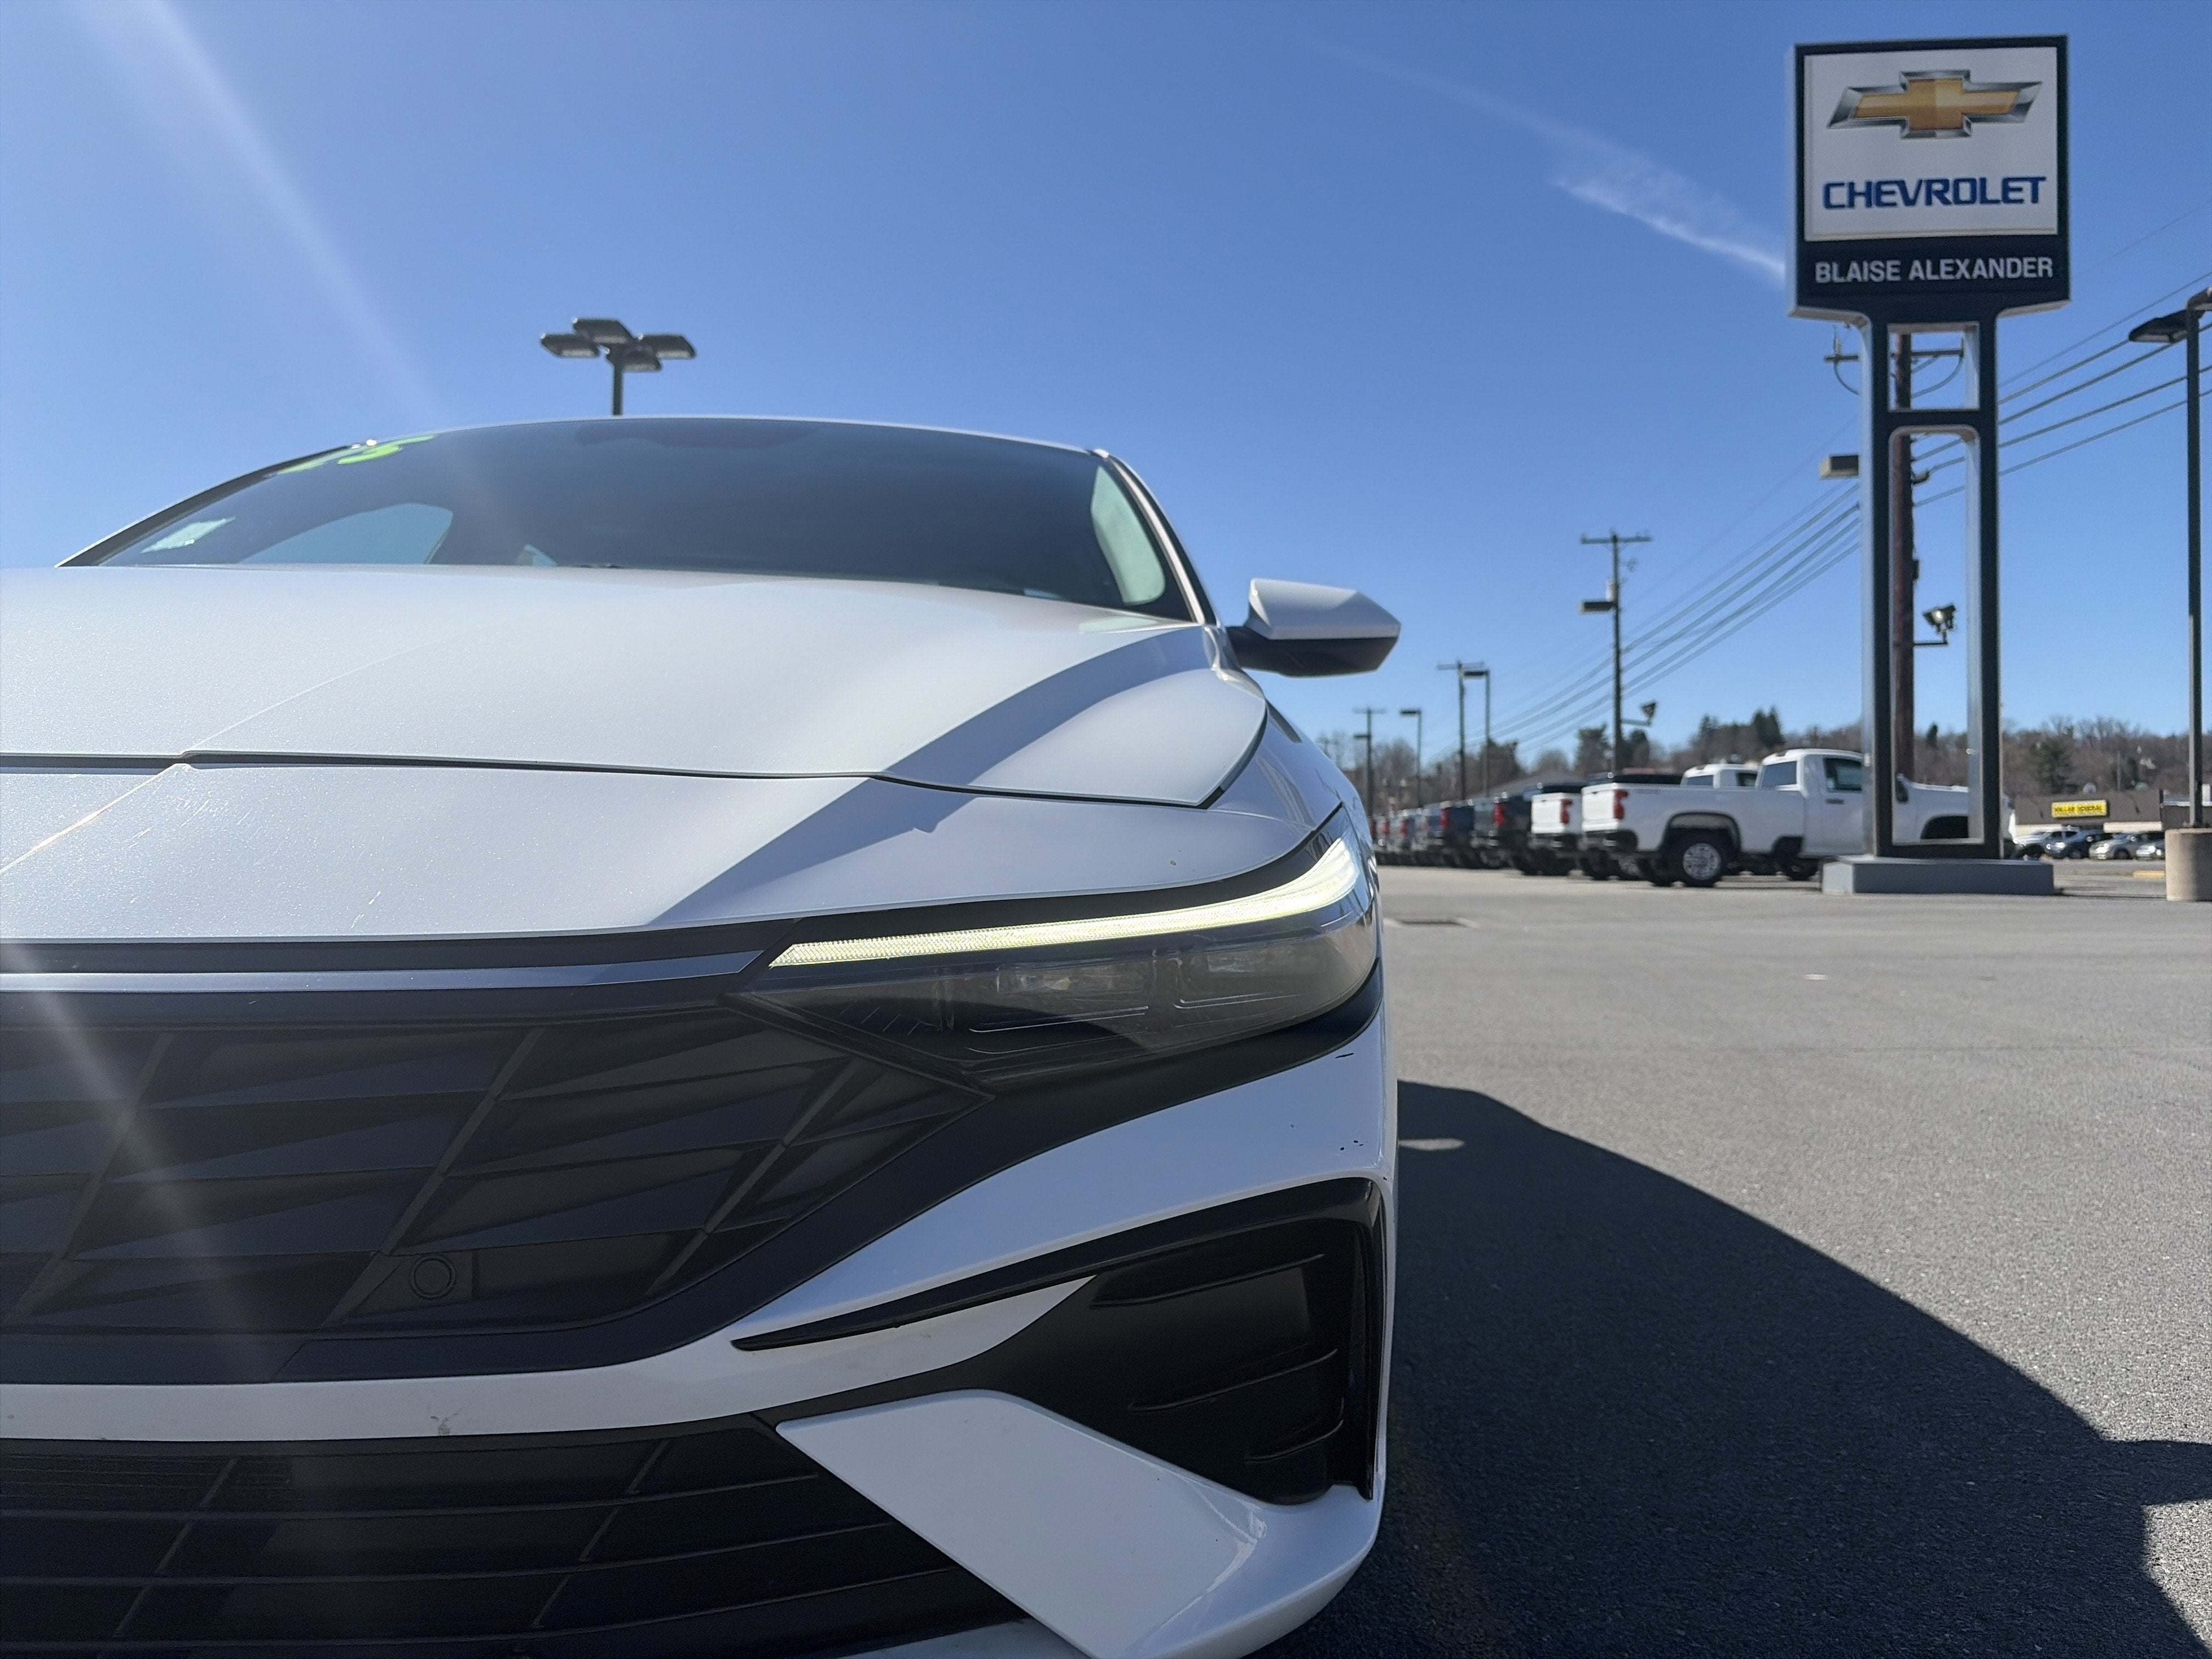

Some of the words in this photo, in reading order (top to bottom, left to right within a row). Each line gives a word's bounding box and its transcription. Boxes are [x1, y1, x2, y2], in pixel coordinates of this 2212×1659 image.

[1823, 176, 2046, 210] CHEVROLET
[1815, 261, 1901, 284] BLAISE
[1908, 257, 2053, 280] ALEXANDER
